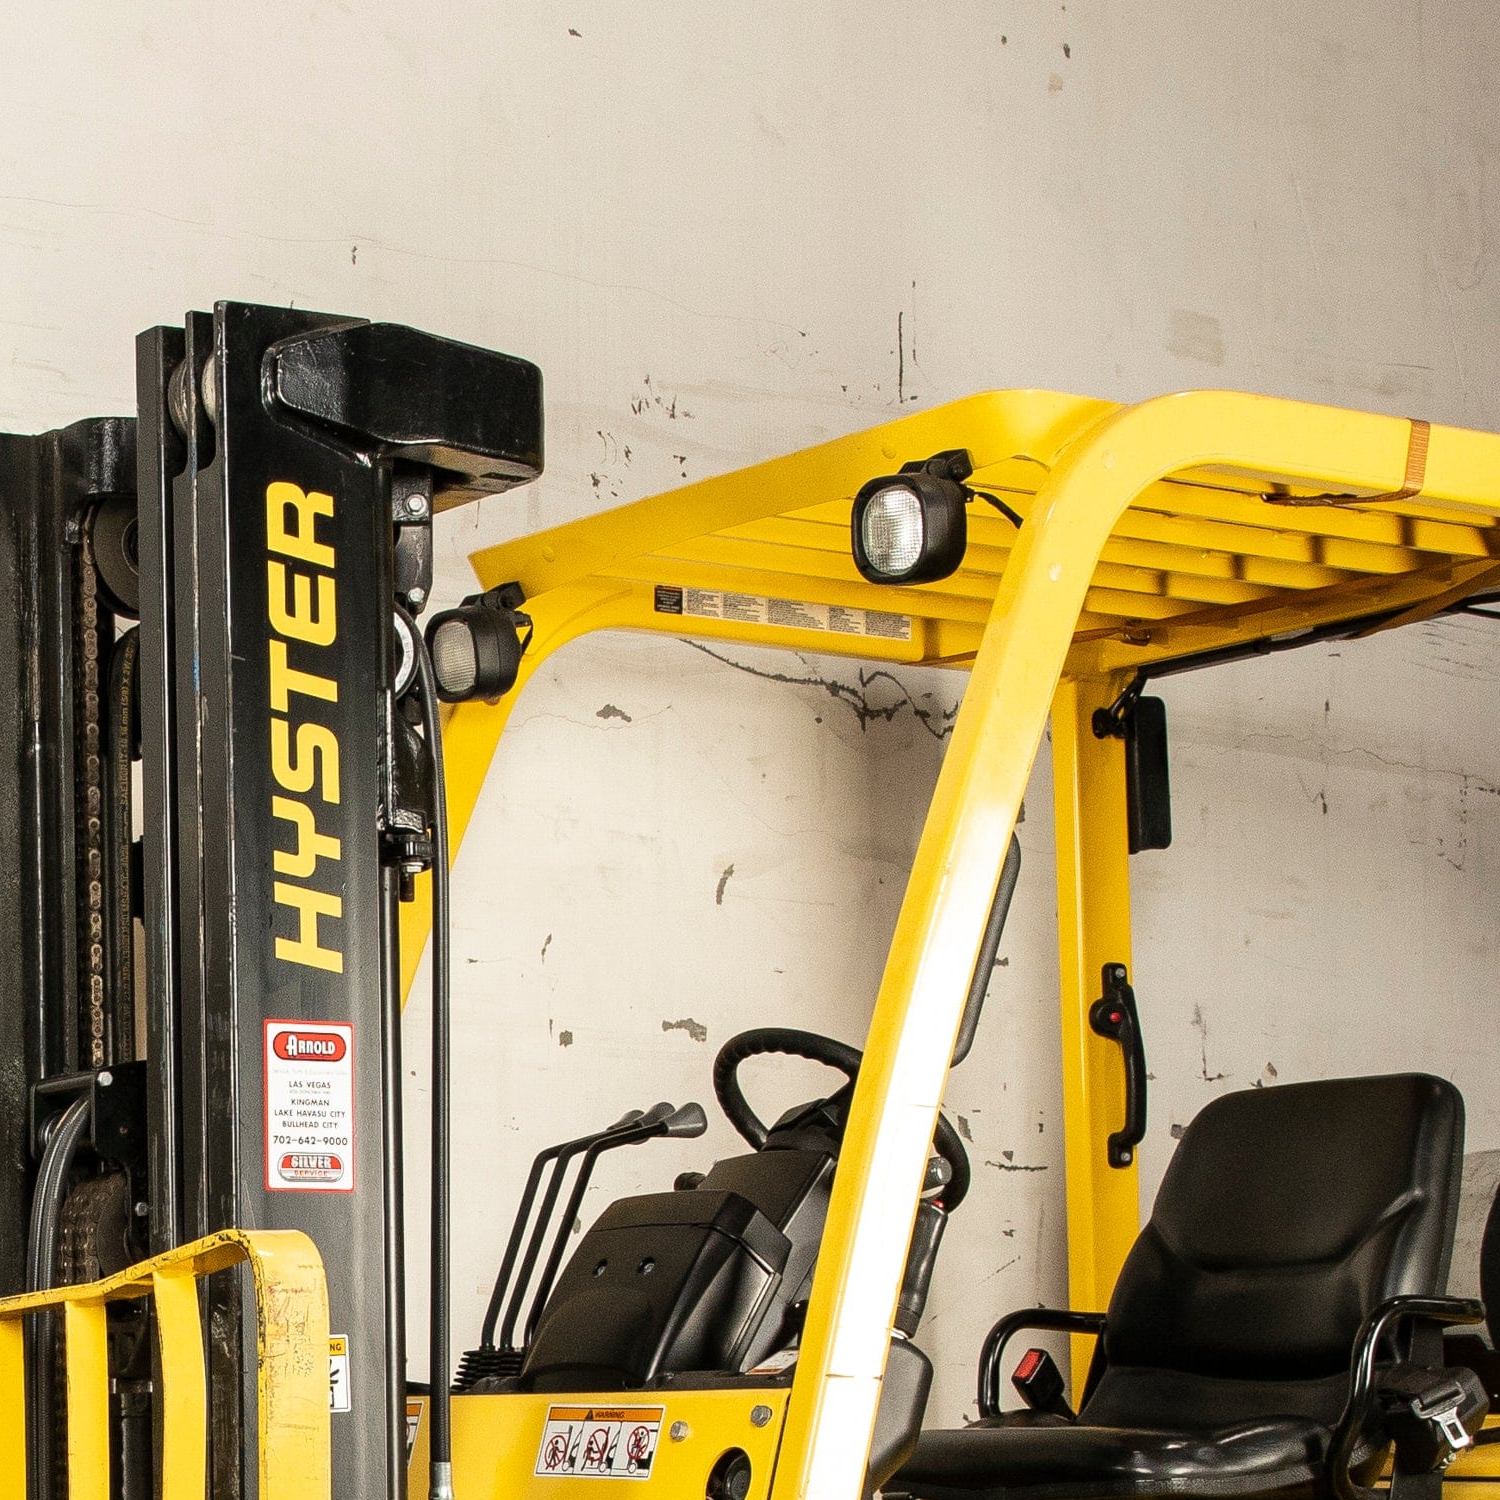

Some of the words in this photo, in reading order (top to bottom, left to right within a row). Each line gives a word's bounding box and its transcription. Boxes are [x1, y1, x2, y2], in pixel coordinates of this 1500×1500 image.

[266, 481, 343, 974] HYSTER
[306, 1081, 331, 1089] VEGAS
[291, 1098, 330, 1107] KINGMAN
[274, 1109, 293, 1117] LAKE
[273, 1135, 348, 1146] 702-642-9000
[290, 1155, 332, 1169] SILVER
